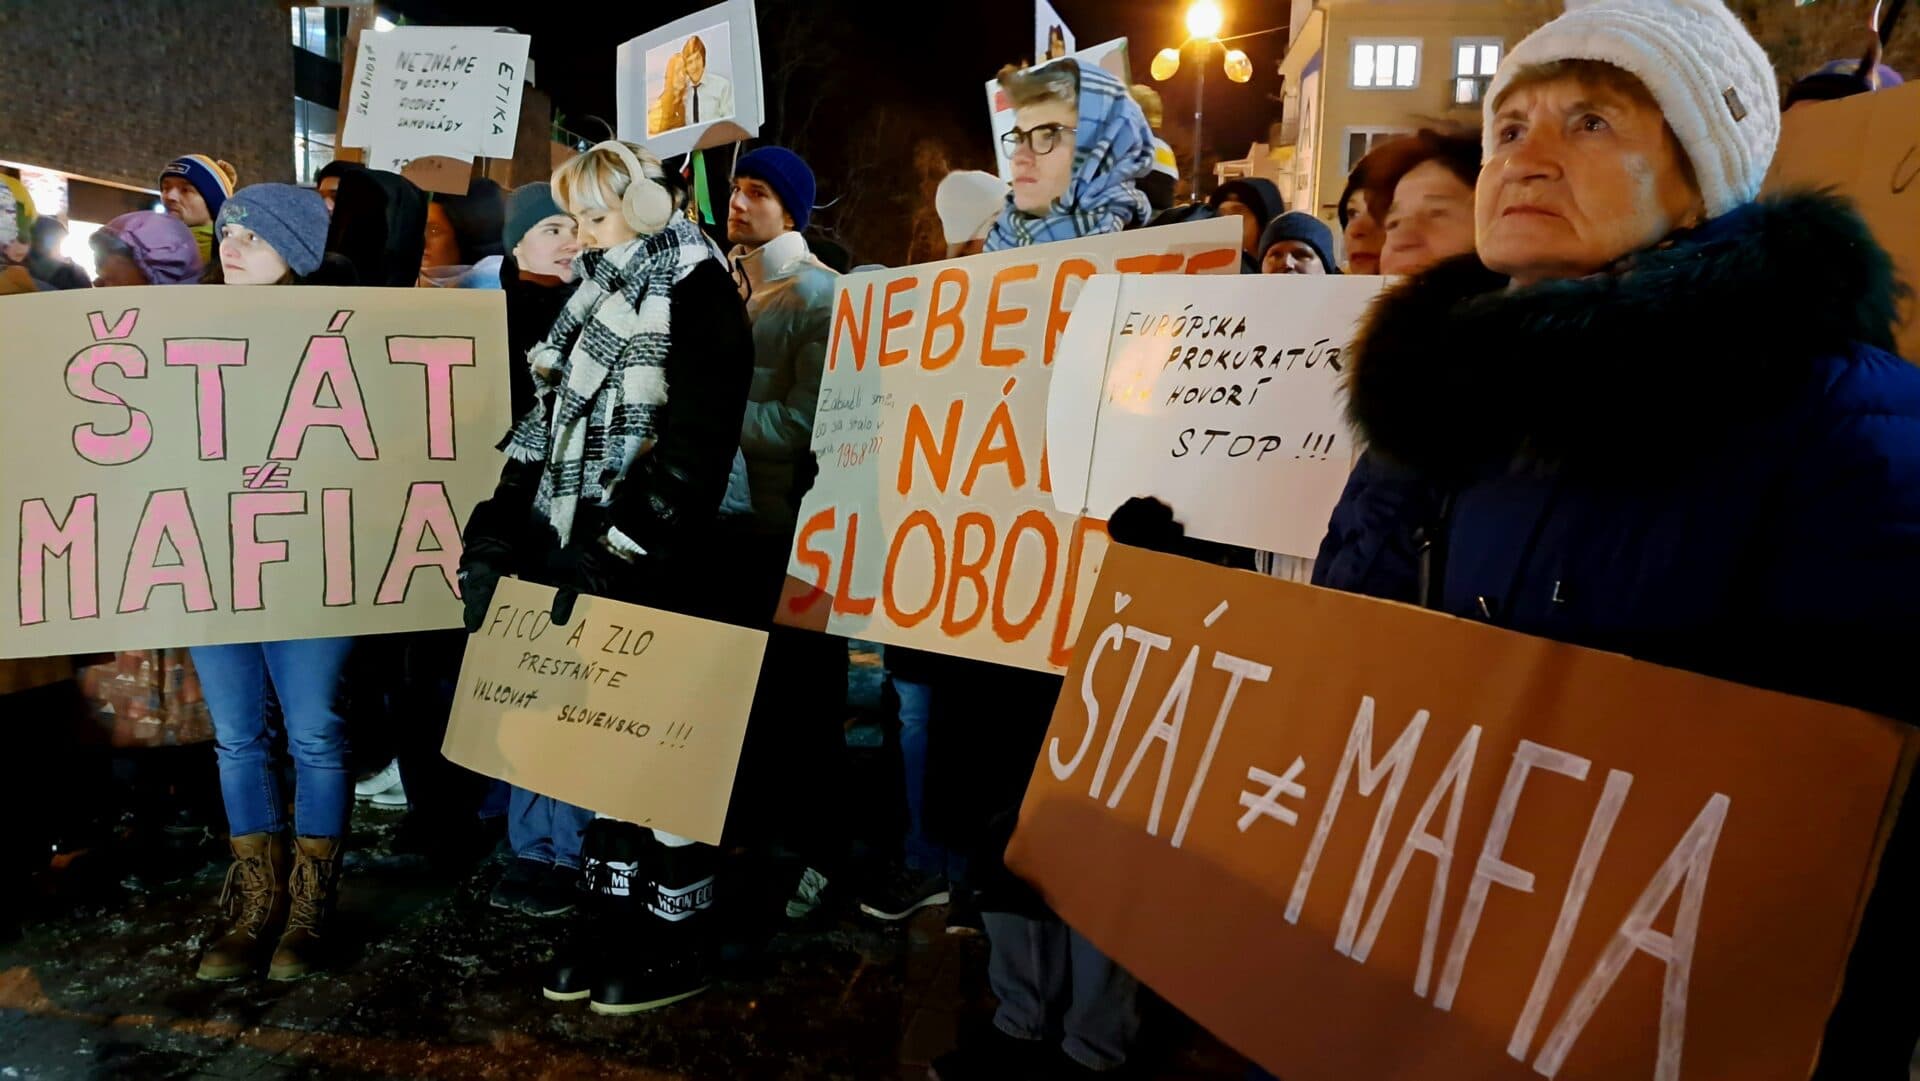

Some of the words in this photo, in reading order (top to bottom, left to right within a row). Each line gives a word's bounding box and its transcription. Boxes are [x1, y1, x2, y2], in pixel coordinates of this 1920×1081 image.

[491, 61, 514, 136] ETIKA
[1119, 303, 1248, 340] EURÓPSKA
[64, 308, 477, 467] ŠTÁT
[1165, 376, 1273, 407] HOVORÍ
[1171, 427, 1282, 462] STOP
[487, 604, 552, 641] FICO
[566, 618, 587, 649] A
[601, 624, 655, 657] ZLO
[557, 704, 651, 739] SLOVENSKO
[1048, 590, 1273, 849] ŠTÁT
[1284, 694, 1732, 1081] MAFIA
